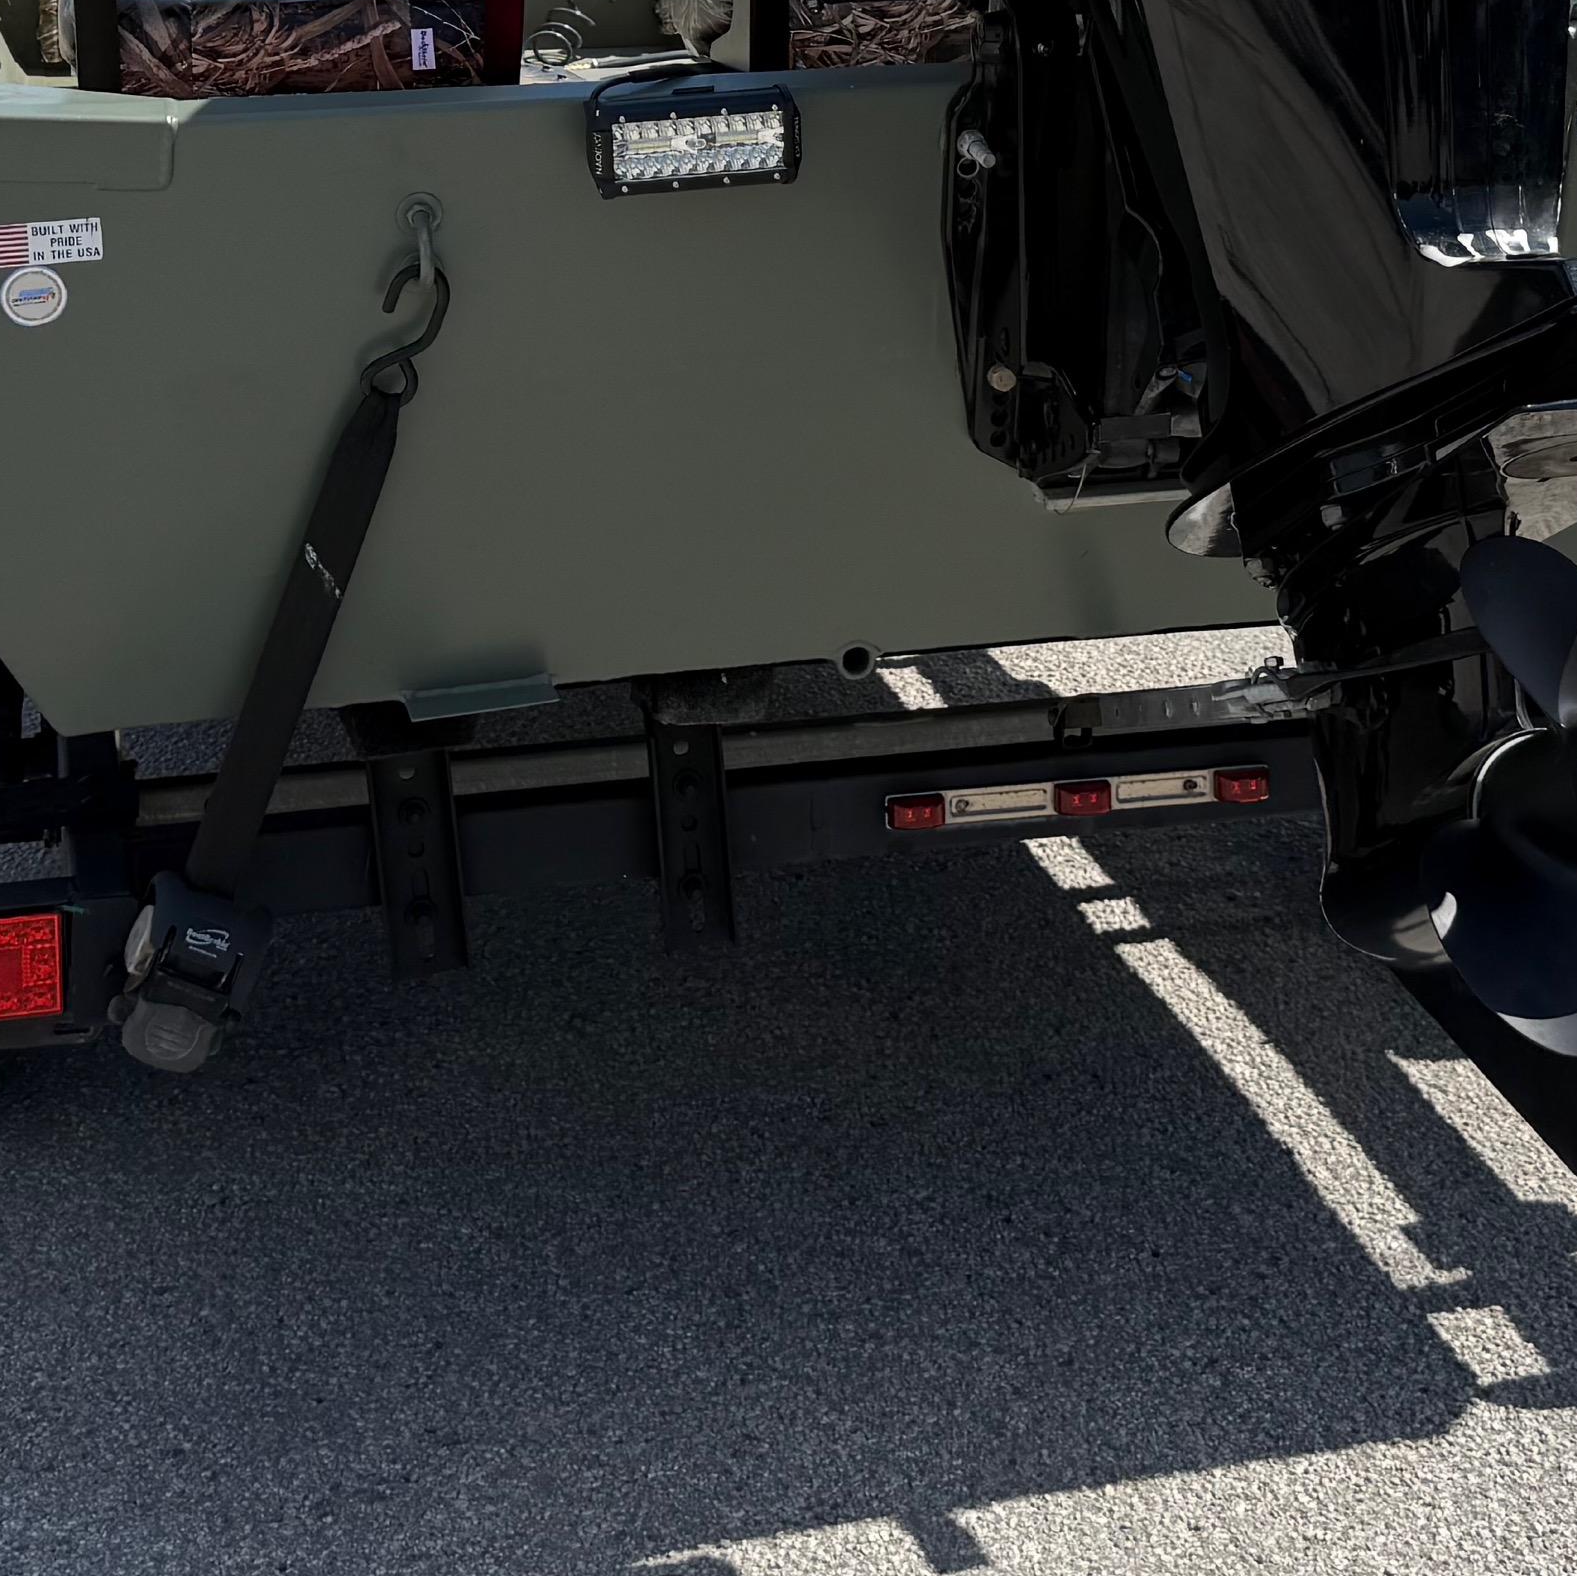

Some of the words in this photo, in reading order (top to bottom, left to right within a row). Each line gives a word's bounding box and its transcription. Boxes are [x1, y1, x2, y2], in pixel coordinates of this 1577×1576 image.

[31, 225, 64, 237] BUILT
[69, 222, 98, 234] WITH
[50, 236, 82, 248] PRIDE
[33, 251, 45, 261] IN
[51, 249, 73, 260] THE
[77, 247, 101, 258] USA
